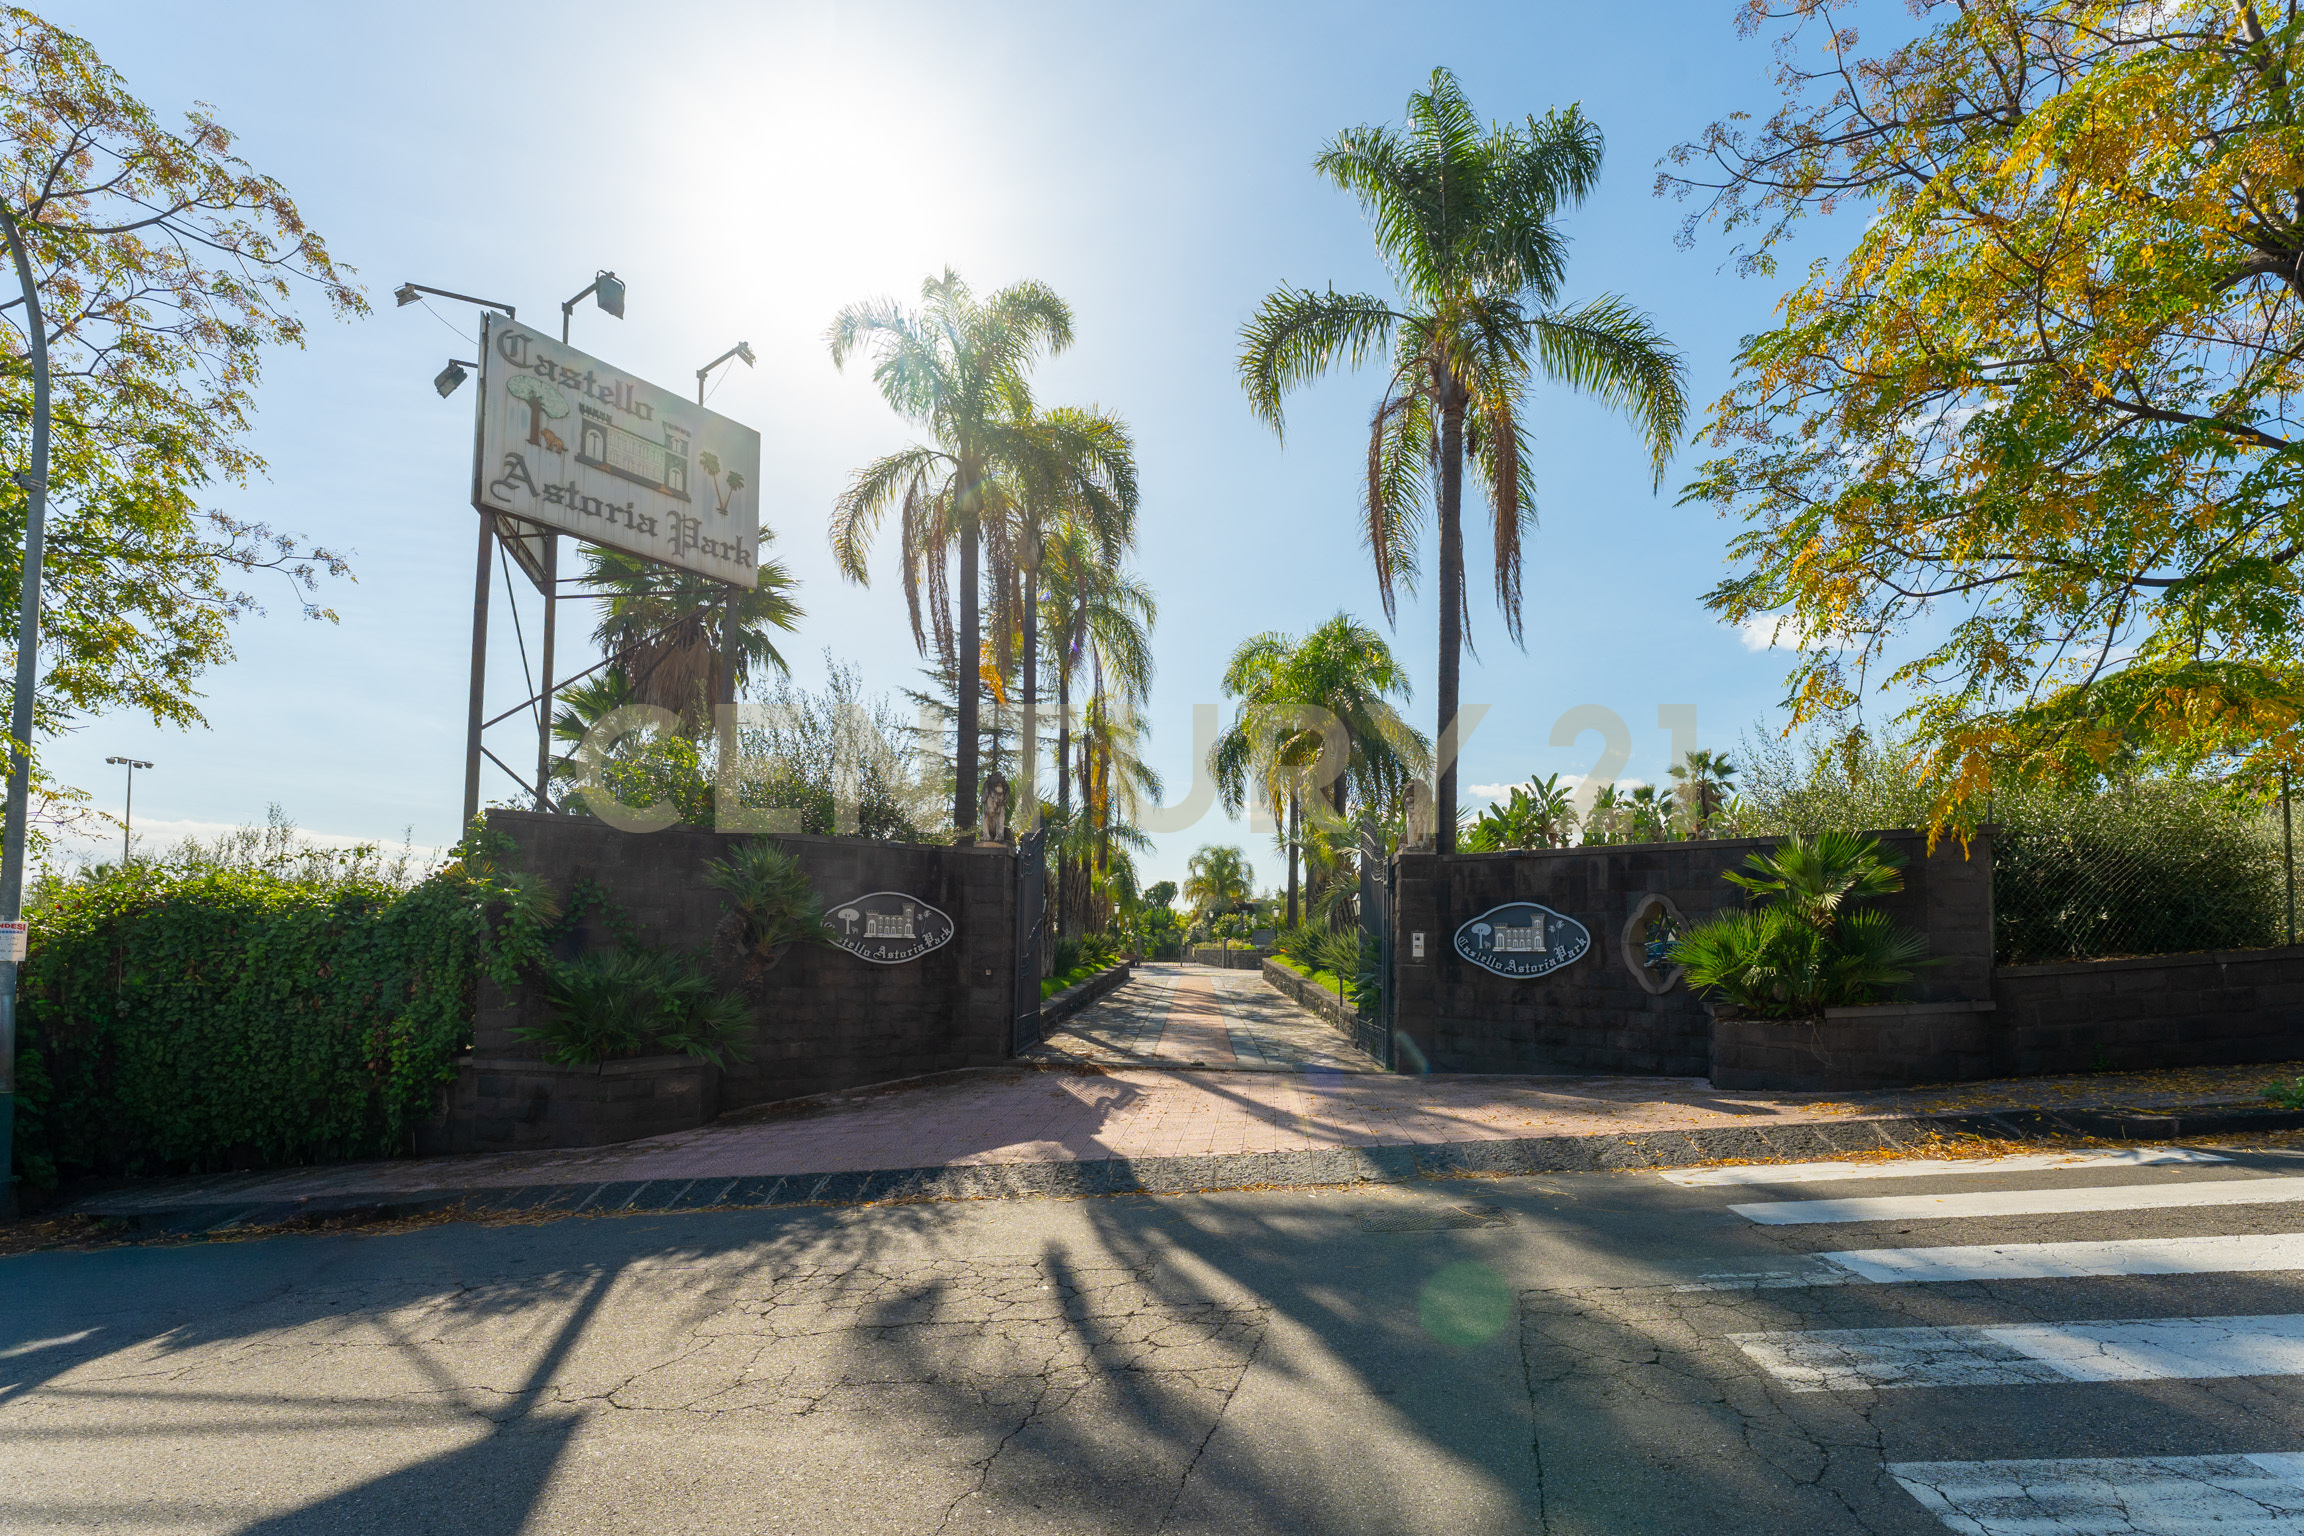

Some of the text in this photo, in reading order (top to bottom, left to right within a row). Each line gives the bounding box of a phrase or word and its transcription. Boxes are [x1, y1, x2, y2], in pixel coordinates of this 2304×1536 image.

[497, 329, 654, 422] Castello
[490, 452, 752, 568] Astoria Park
[873, 944, 925, 959] Astoria
[922, 927, 951, 948] Park
[1458, 936, 1587, 973] Castello Astoria Park
